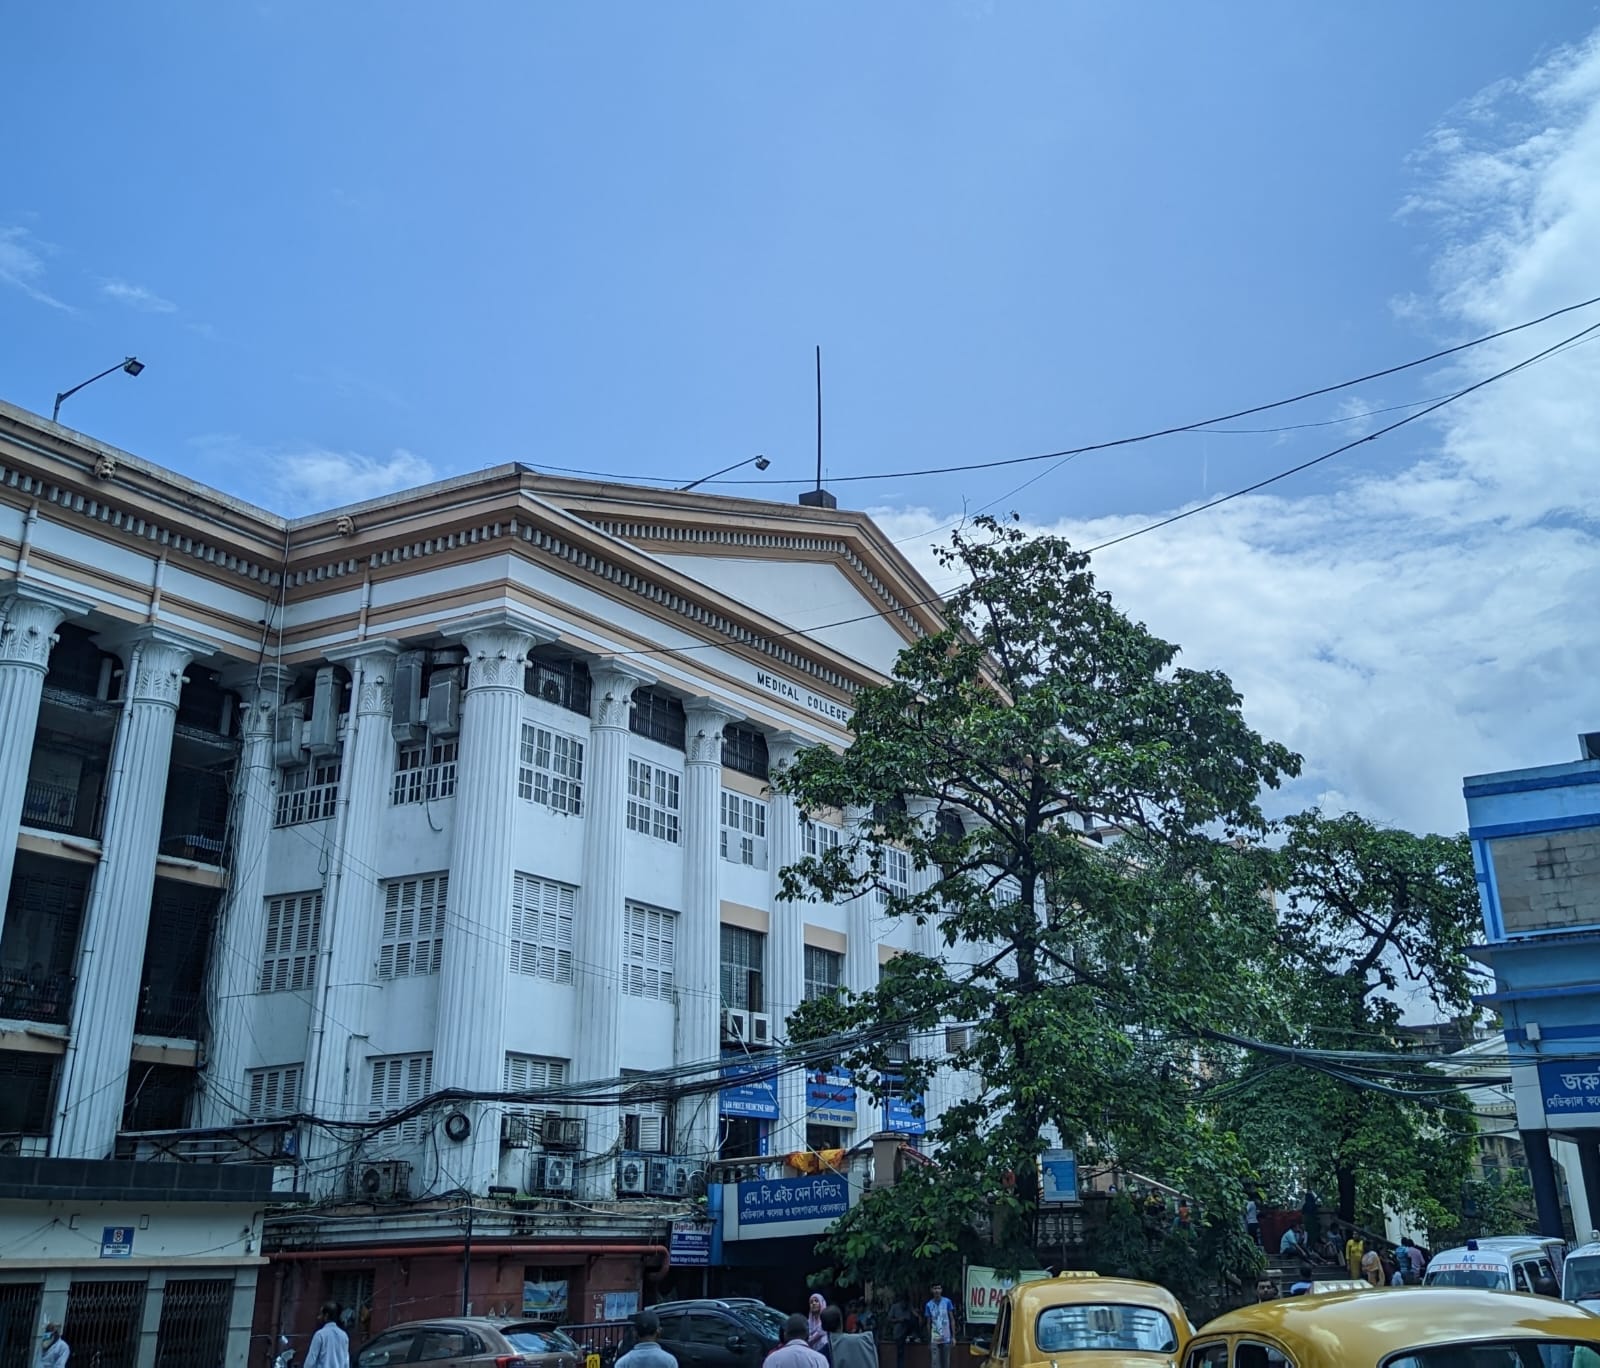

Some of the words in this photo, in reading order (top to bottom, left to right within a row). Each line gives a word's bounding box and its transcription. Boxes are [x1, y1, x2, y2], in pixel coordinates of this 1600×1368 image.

[757, 672, 799, 701] MEDICAL
[807, 696, 847, 722] COLLEGE
[1560, 1066, 1600, 1090] জরু
[1546, 1094, 1584, 1108] মেডিক্যাল
[970, 1286, 986, 1308] NO
[989, 1287, 1006, 1308] PA
